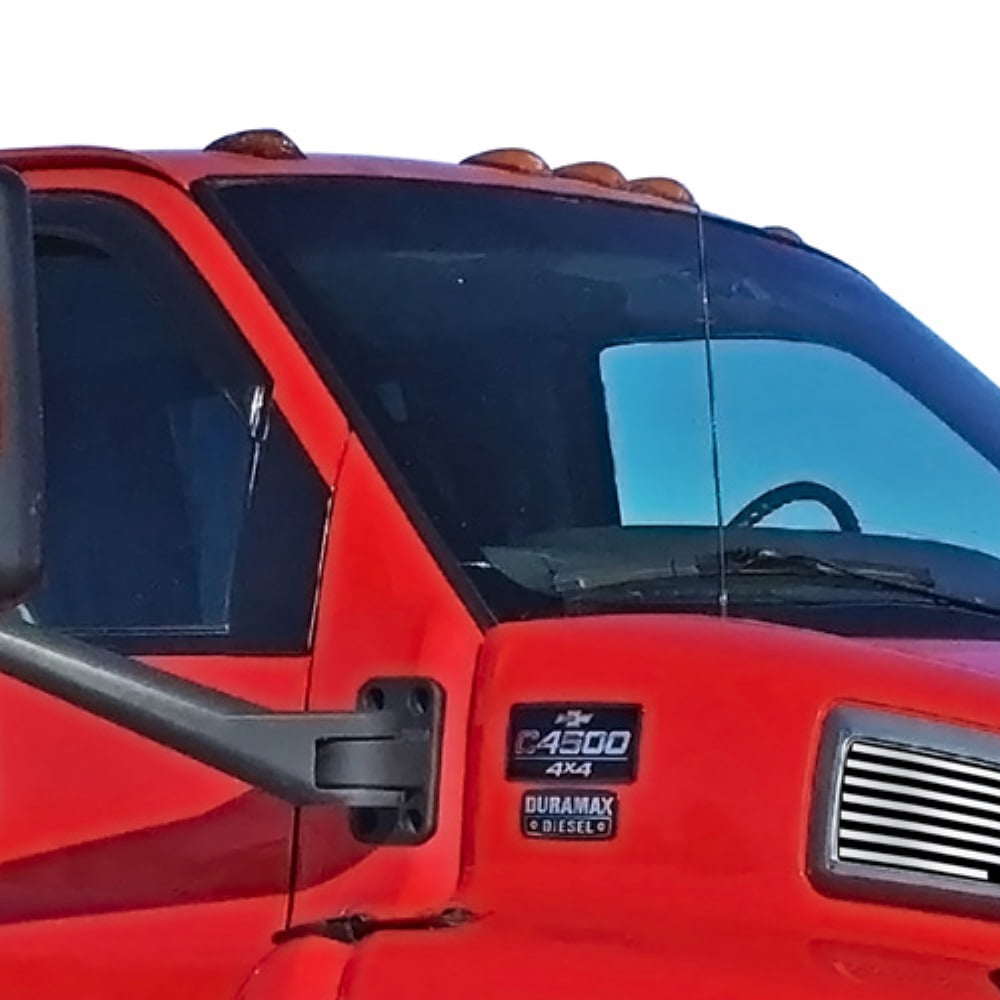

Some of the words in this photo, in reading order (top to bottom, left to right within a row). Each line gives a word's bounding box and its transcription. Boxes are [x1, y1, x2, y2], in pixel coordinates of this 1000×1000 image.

[515, 729, 632, 755] C4500
[525, 795, 614, 816] DURAMAX
[542, 819, 594, 834] DIESEL
